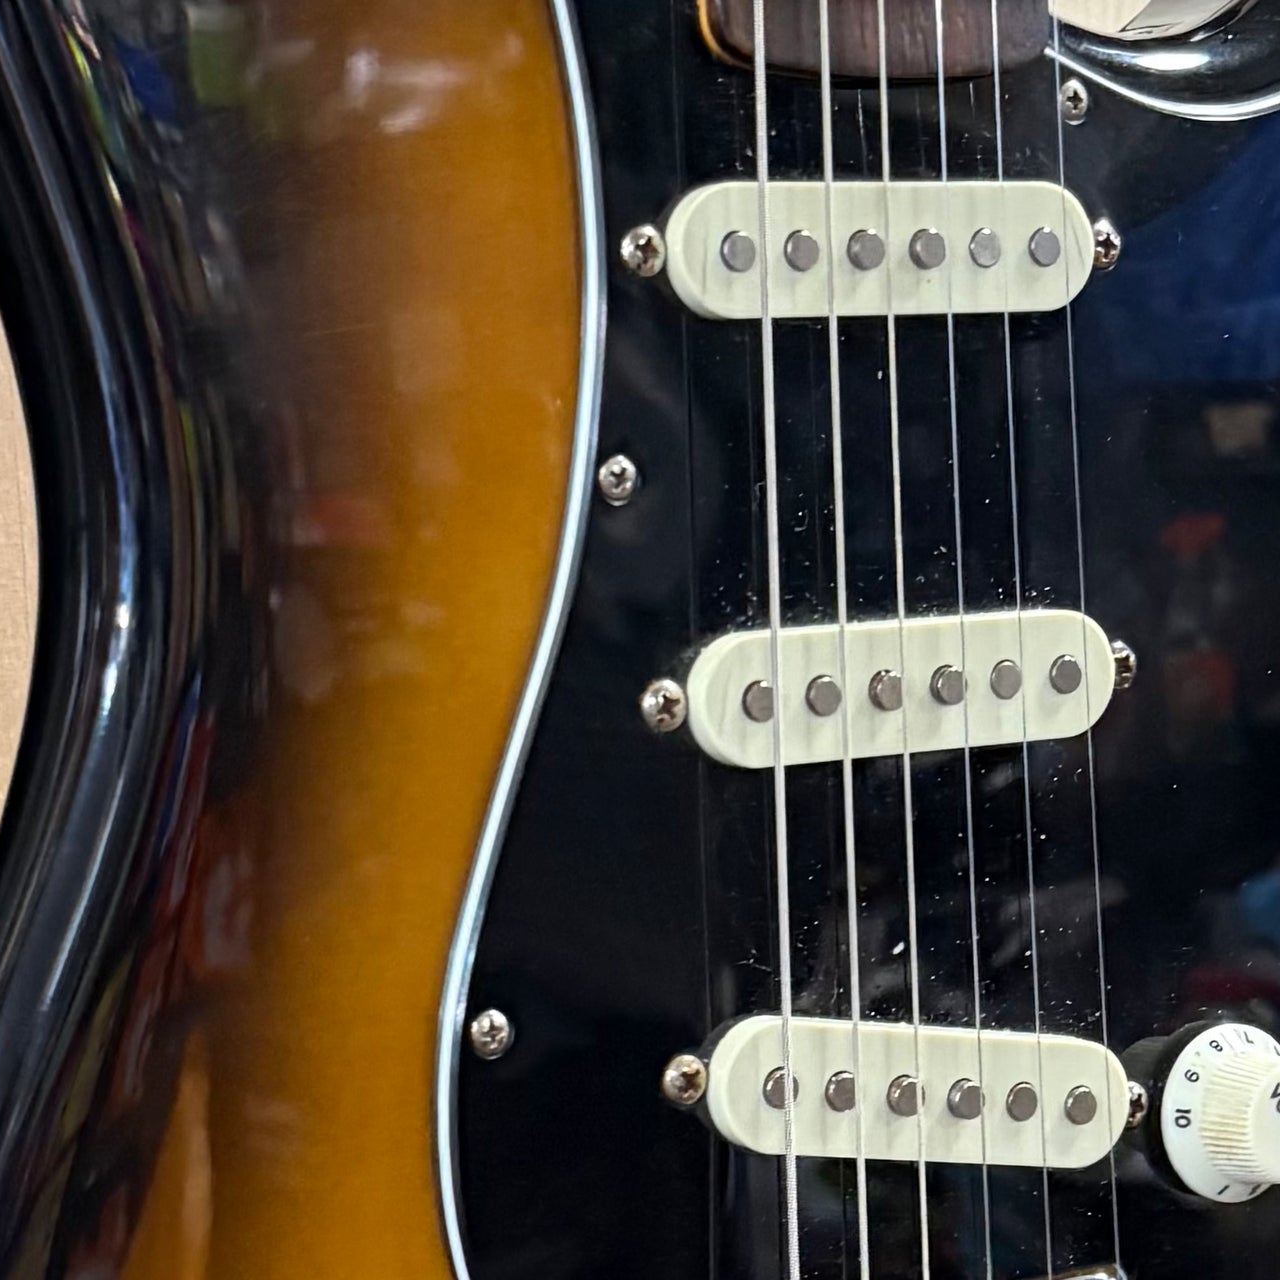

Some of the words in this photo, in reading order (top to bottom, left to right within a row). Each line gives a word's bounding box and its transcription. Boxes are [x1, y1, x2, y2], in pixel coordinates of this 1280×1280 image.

[1208, 1039, 1224, 1053] 8
[1183, 1068, 1201, 1083] 9
[1174, 1107, 1193, 1129] 10
